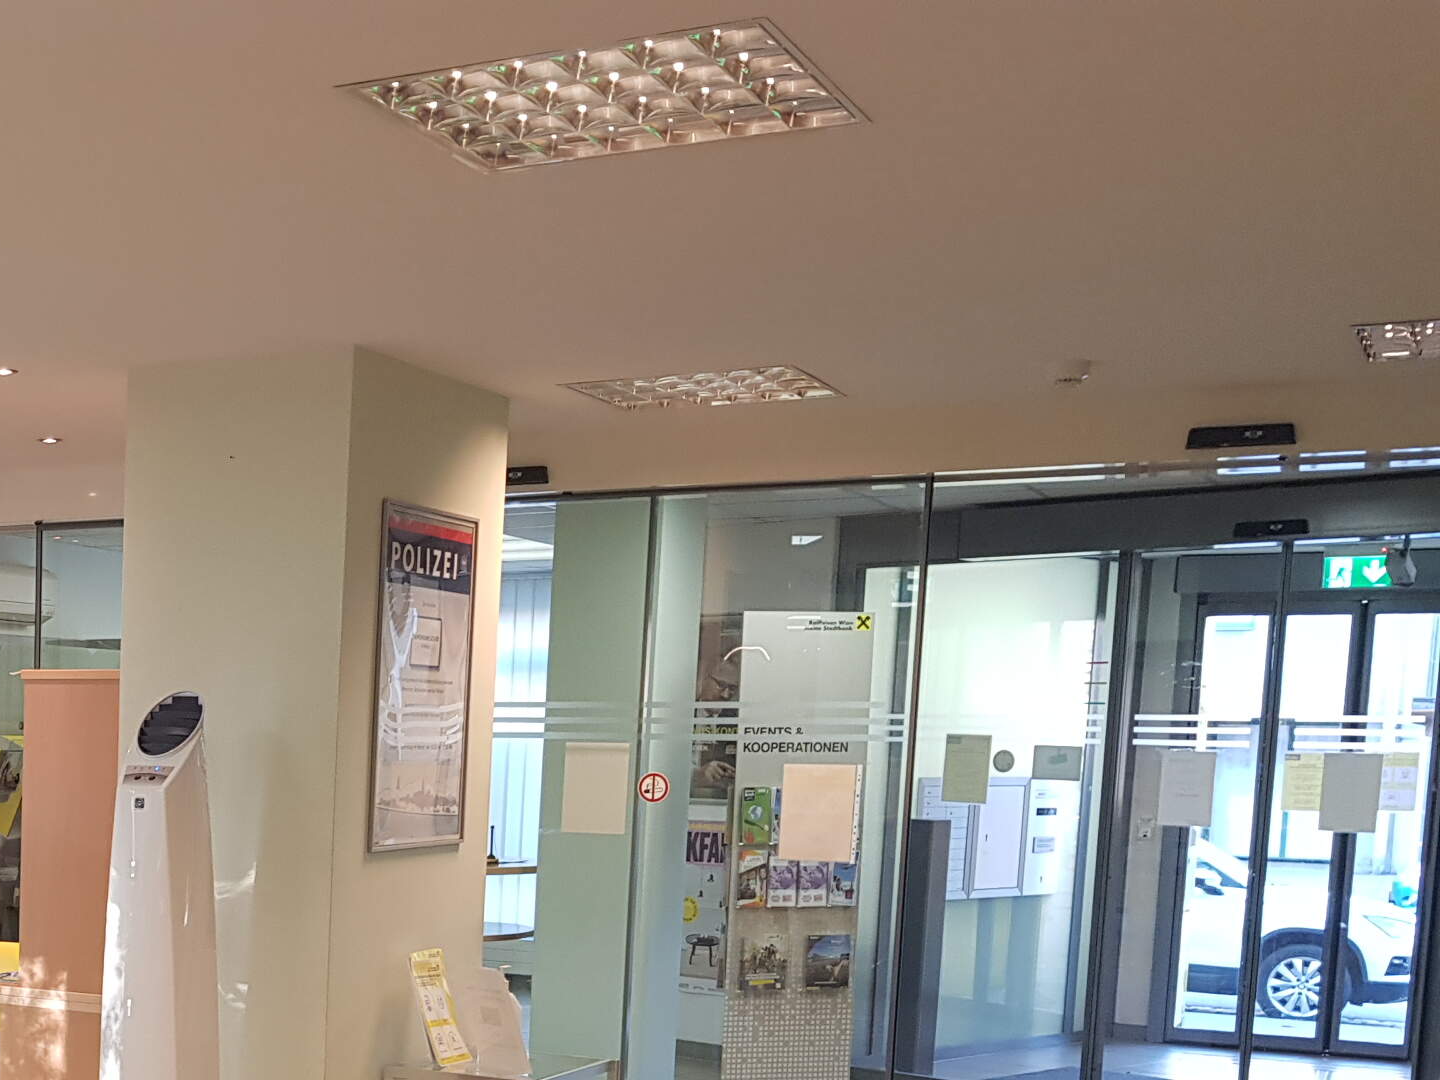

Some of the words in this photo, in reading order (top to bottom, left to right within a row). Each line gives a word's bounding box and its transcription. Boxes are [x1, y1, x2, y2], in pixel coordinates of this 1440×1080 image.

[391, 541, 458, 580] POLIZEI
[743, 727, 792, 735] EVENTS
[743, 741, 849, 753] KOOPERATIONEN
